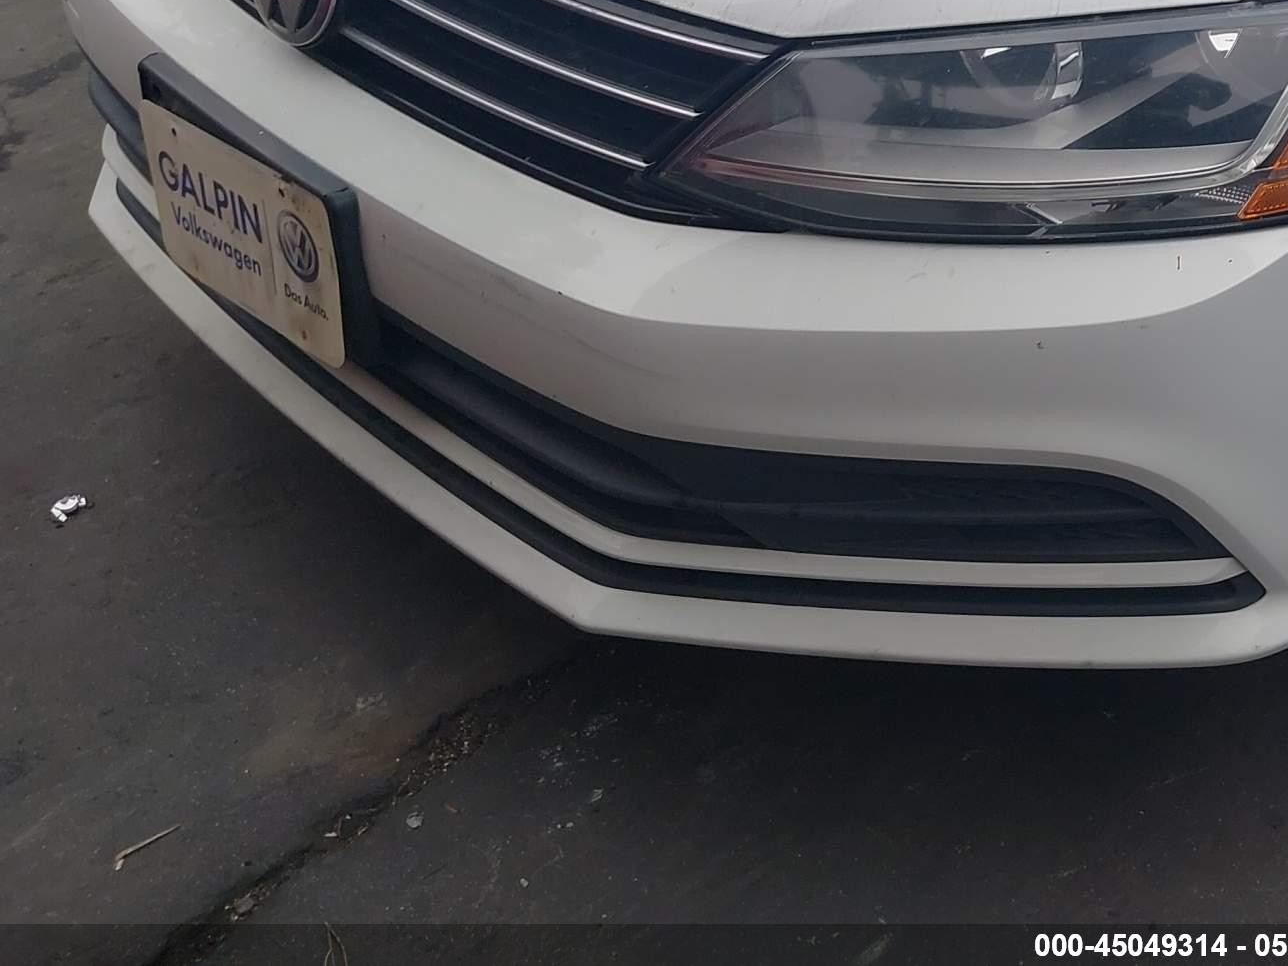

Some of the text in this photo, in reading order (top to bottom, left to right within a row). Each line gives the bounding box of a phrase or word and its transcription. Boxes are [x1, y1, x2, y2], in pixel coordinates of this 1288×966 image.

[158, 150, 264, 244] GALPIN
[170, 202, 262, 277] Volkswagen
[284, 283, 303, 305] Das
